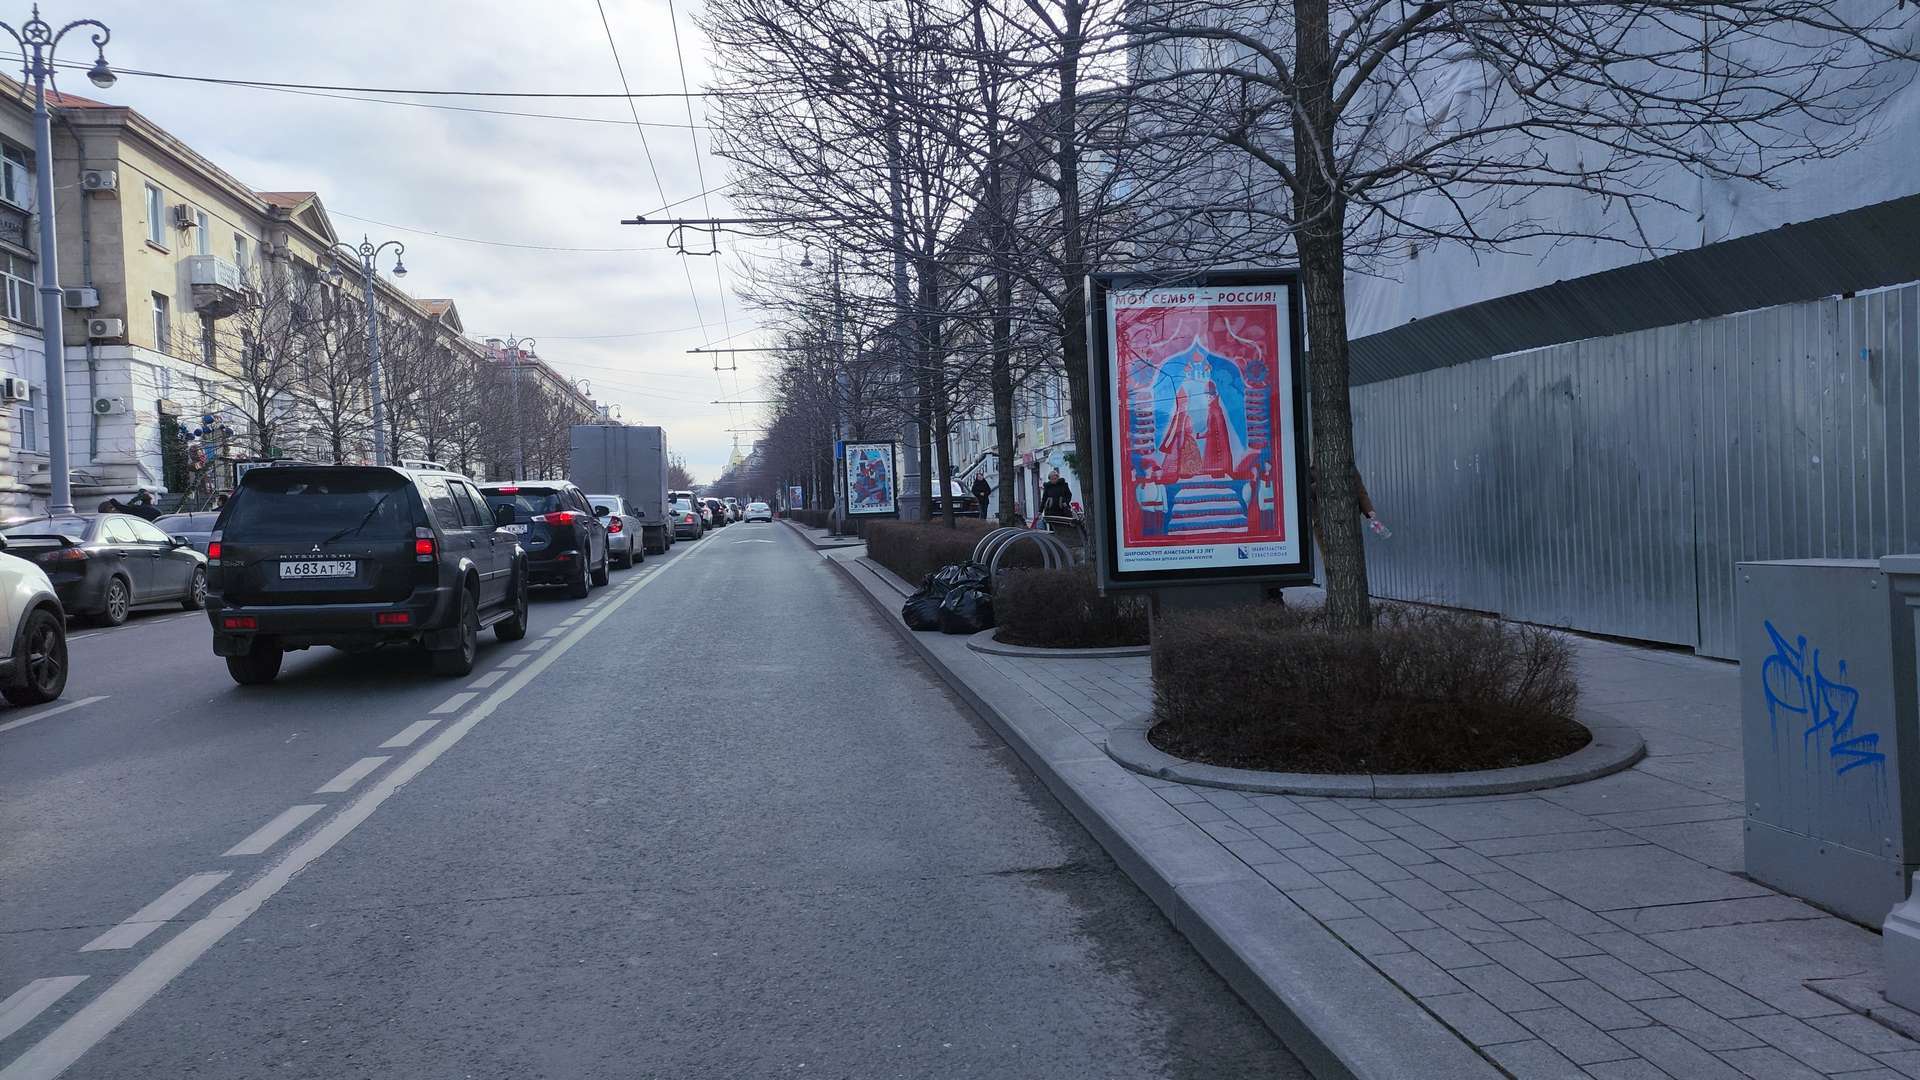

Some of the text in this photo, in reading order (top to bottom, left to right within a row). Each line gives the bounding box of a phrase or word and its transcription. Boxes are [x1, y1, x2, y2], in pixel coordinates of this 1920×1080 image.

[1115, 294, 1147, 306] МОЯ
[1152, 293, 1195, 304] СЕМЬЯ
[1218, 291, 1277, 304] РОССИЯ!
